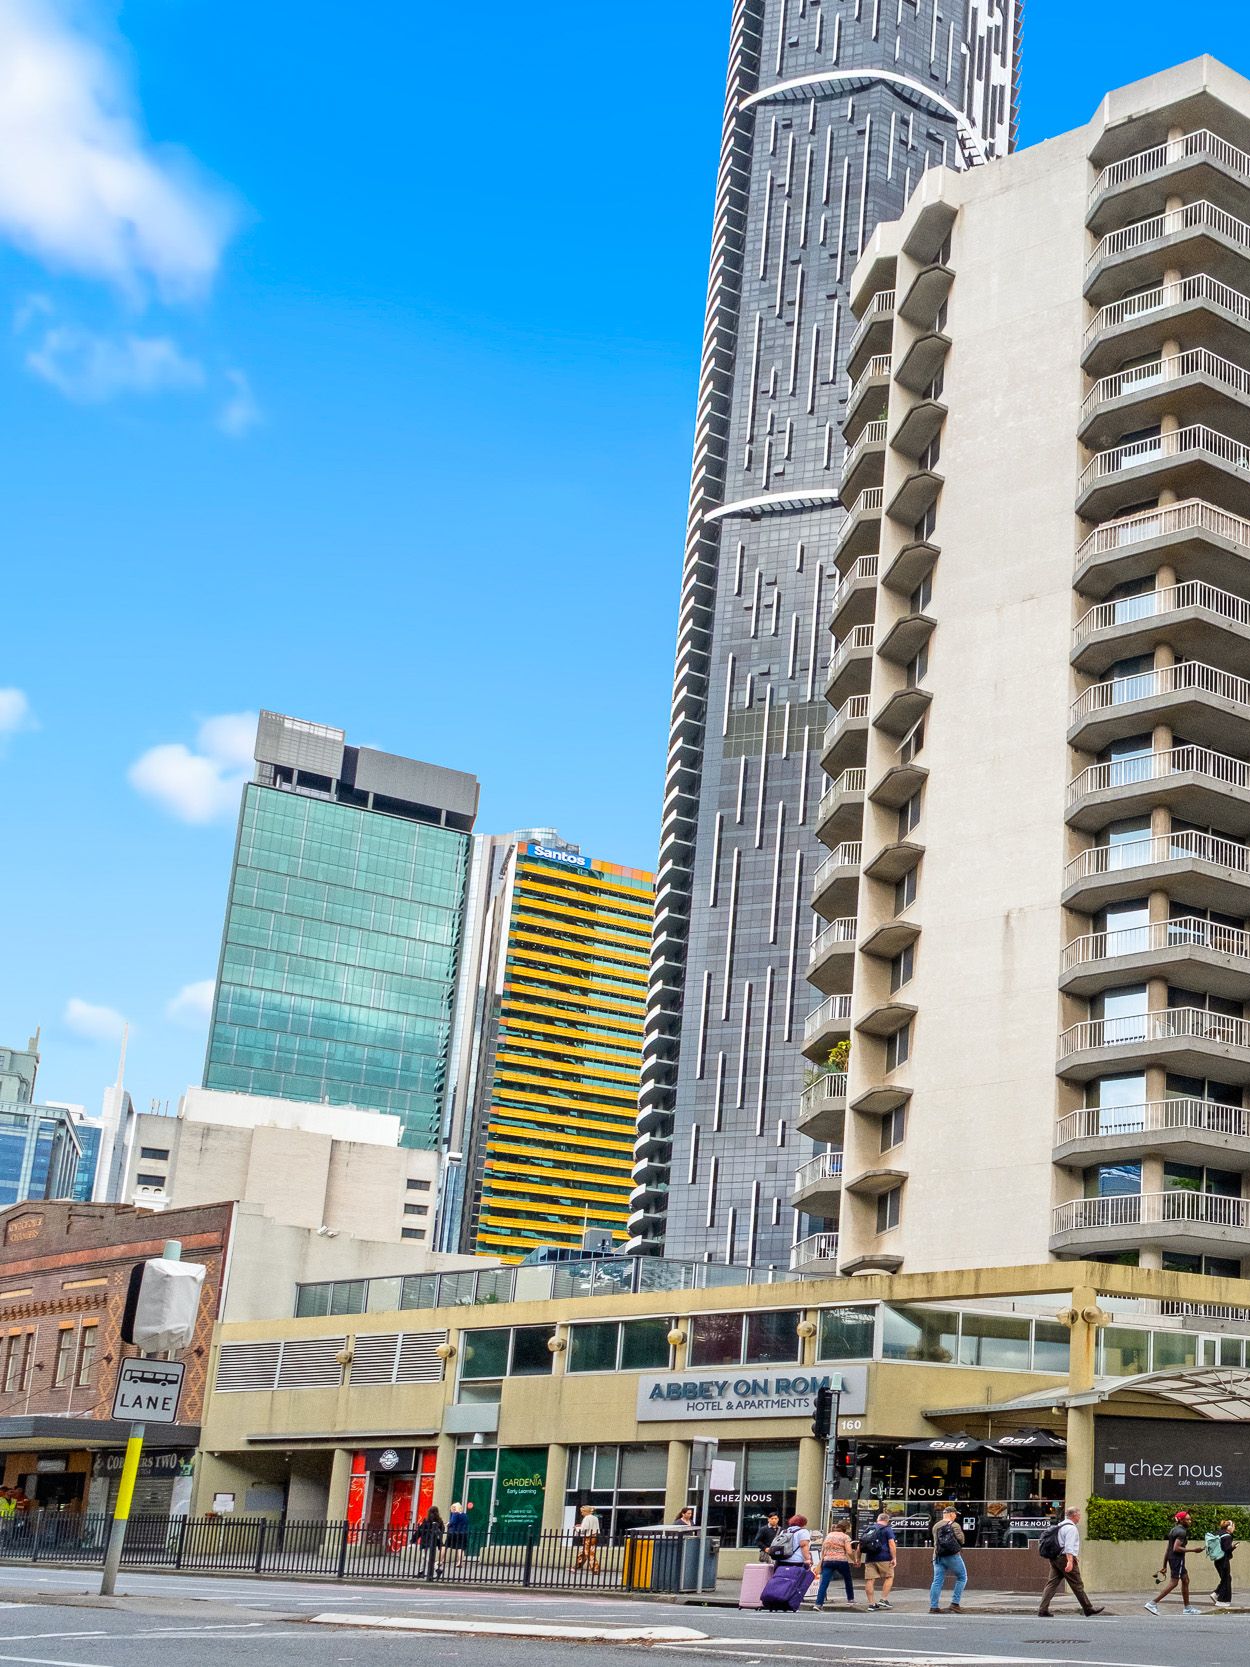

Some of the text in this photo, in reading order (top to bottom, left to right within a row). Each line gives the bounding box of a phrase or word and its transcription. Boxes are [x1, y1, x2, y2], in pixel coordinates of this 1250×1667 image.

[534, 845, 586, 866] Santos
[649, 1380, 729, 1400] ABBEY
[733, 1379, 769, 1396] ON
[120, 1394, 173, 1411] LANE
[687, 1398, 810, 1411] HOTEL & APARTMENTS
[841, 1420, 862, 1430] 160
[155, 1453, 177, 1469] TWO
[1129, 1458, 1223, 1478] chez nous
[502, 1478, 543, 1487] GARDENIA
[1195, 1480, 1223, 1488] takeaway
[714, 1494, 772, 1503] CHEZ NOUS
[870, 1487, 944, 1497] CHEZ NOUS
